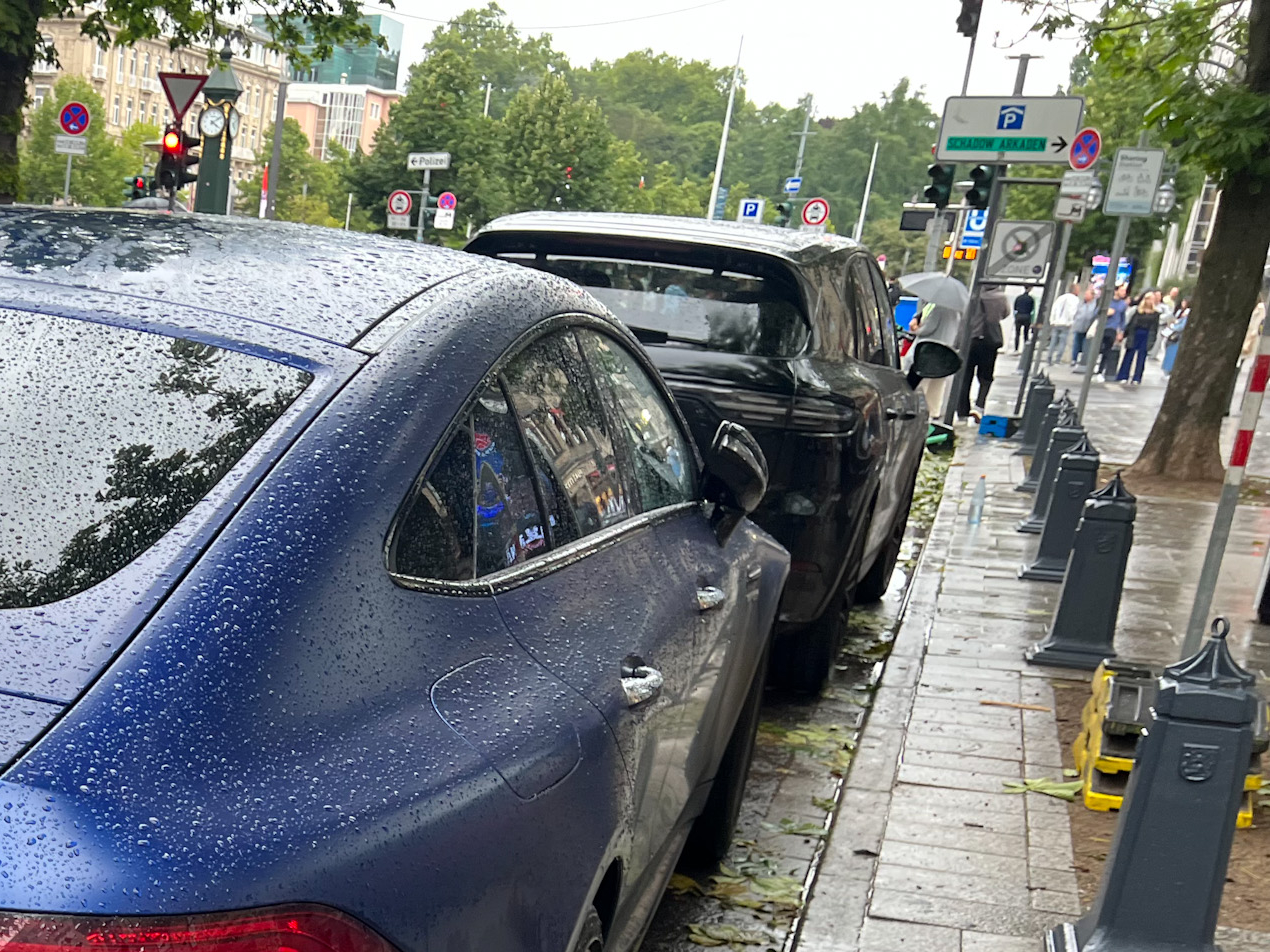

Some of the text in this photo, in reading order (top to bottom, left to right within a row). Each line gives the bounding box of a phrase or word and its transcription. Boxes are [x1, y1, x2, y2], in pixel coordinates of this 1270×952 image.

[947, 136, 1046, 151] SCHADOW ARKADEN
[419, 156, 447, 166] Polizei
